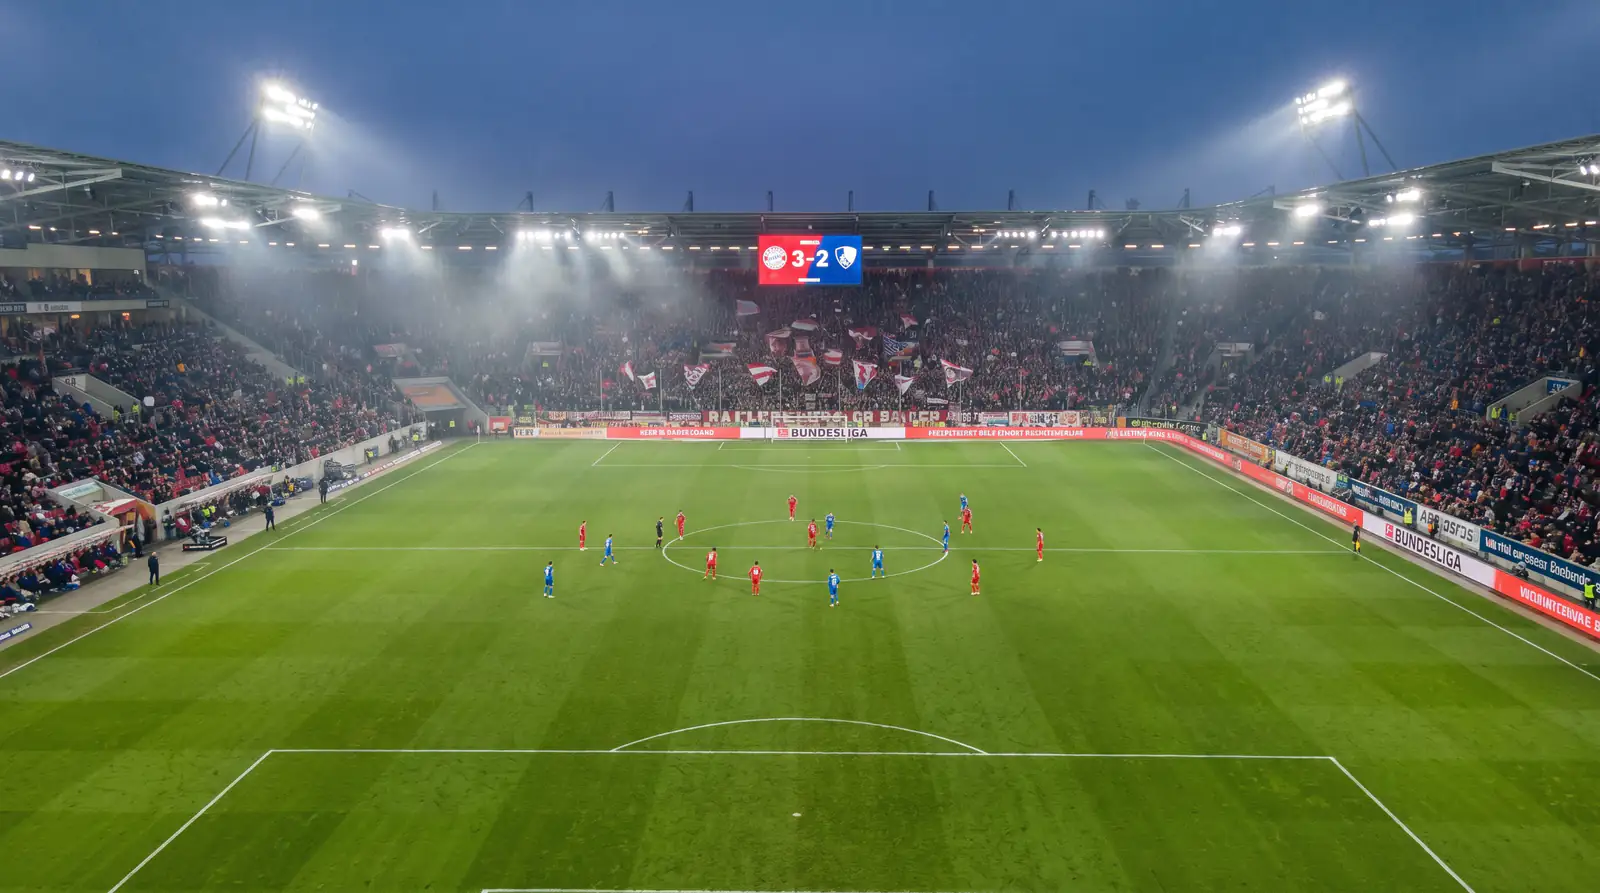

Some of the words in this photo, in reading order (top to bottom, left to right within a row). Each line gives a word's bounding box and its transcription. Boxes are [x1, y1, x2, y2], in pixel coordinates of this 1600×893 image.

[791, 249, 829, 268] 3-2
[791, 428, 868, 437] BUNDESLIGA
[1395, 528, 1462, 572] BUNDESLIGA
